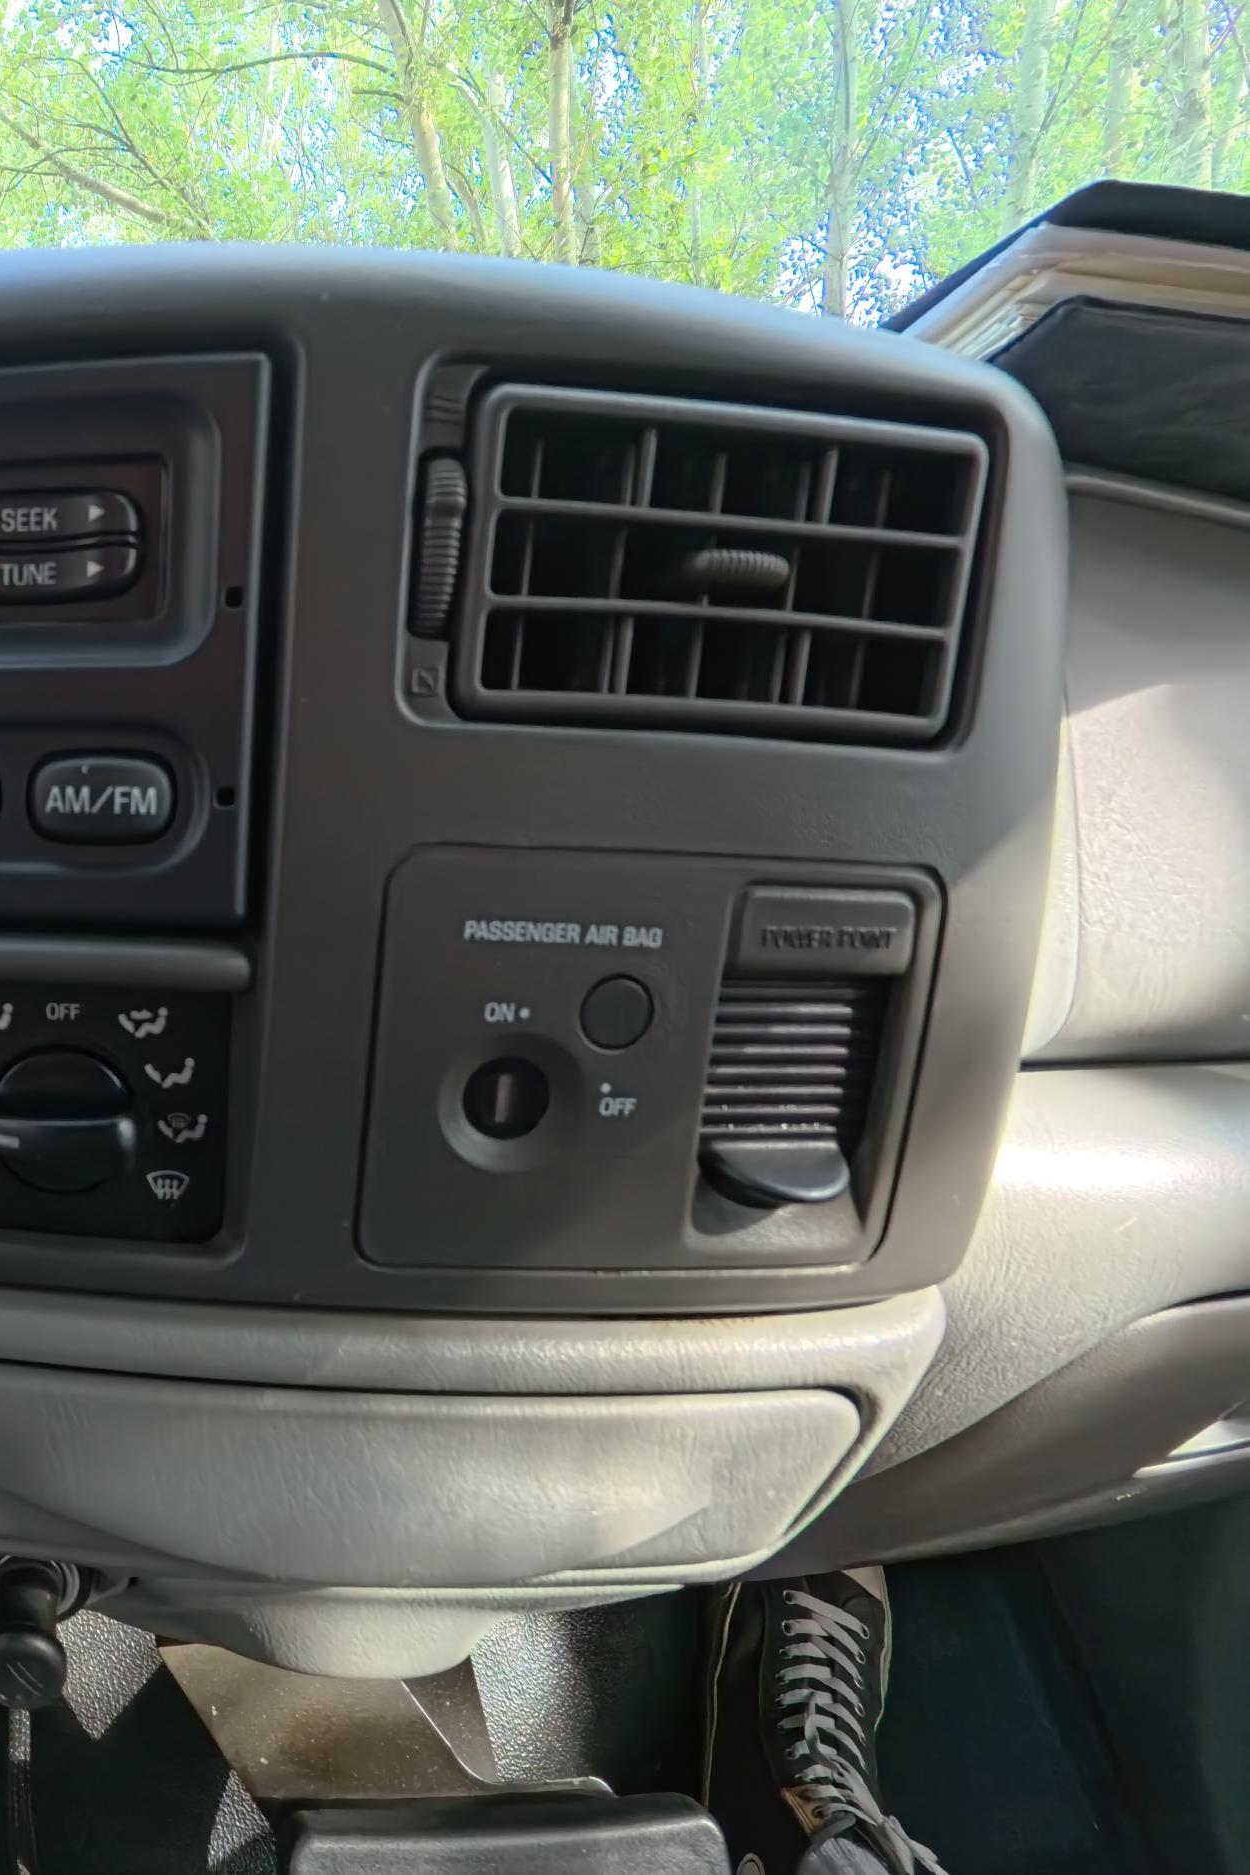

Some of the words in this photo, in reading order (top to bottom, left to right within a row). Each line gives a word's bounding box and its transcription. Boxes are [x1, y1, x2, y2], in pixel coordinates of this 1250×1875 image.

[1, 507, 58, 532] SEEK
[0, 563, 56, 586] TUNE
[45, 785, 157, 815] AM/FM
[463, 919, 581, 945] PASSENGER
[584, 924, 618, 946] AIR
[622, 926, 664, 948] BAG
[45, 1002, 80, 1020] OFF
[484, 1002, 515, 1023] ON
[599, 1098, 637, 1117] OFF
